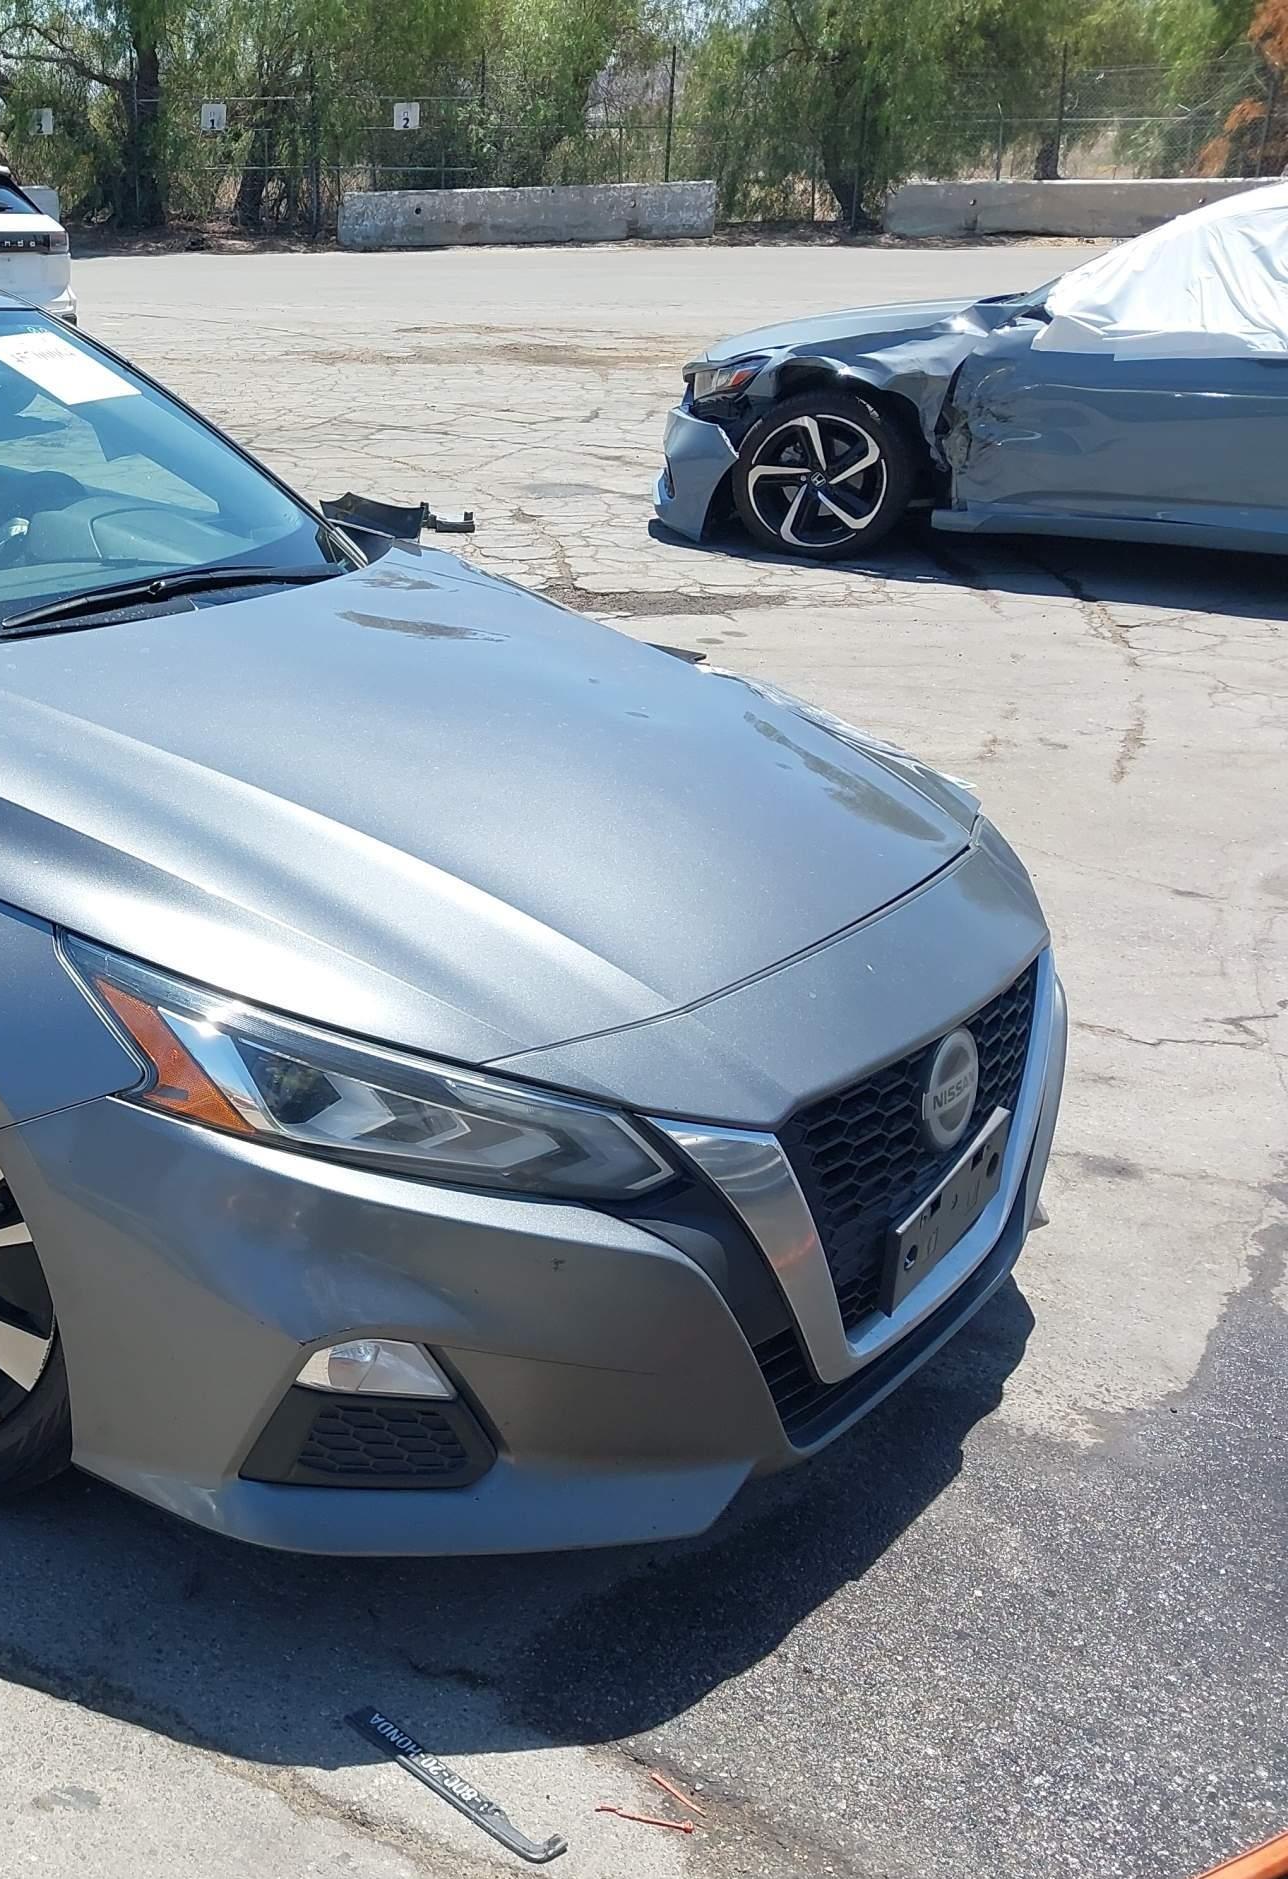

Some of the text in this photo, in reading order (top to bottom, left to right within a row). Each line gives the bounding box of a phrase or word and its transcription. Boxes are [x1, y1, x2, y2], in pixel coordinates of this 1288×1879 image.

[210, 119, 216, 129] 1
[402, 117, 410, 128] 2
[36, 123, 43, 133] 2
[933, 1070, 976, 1111] NISSAN
